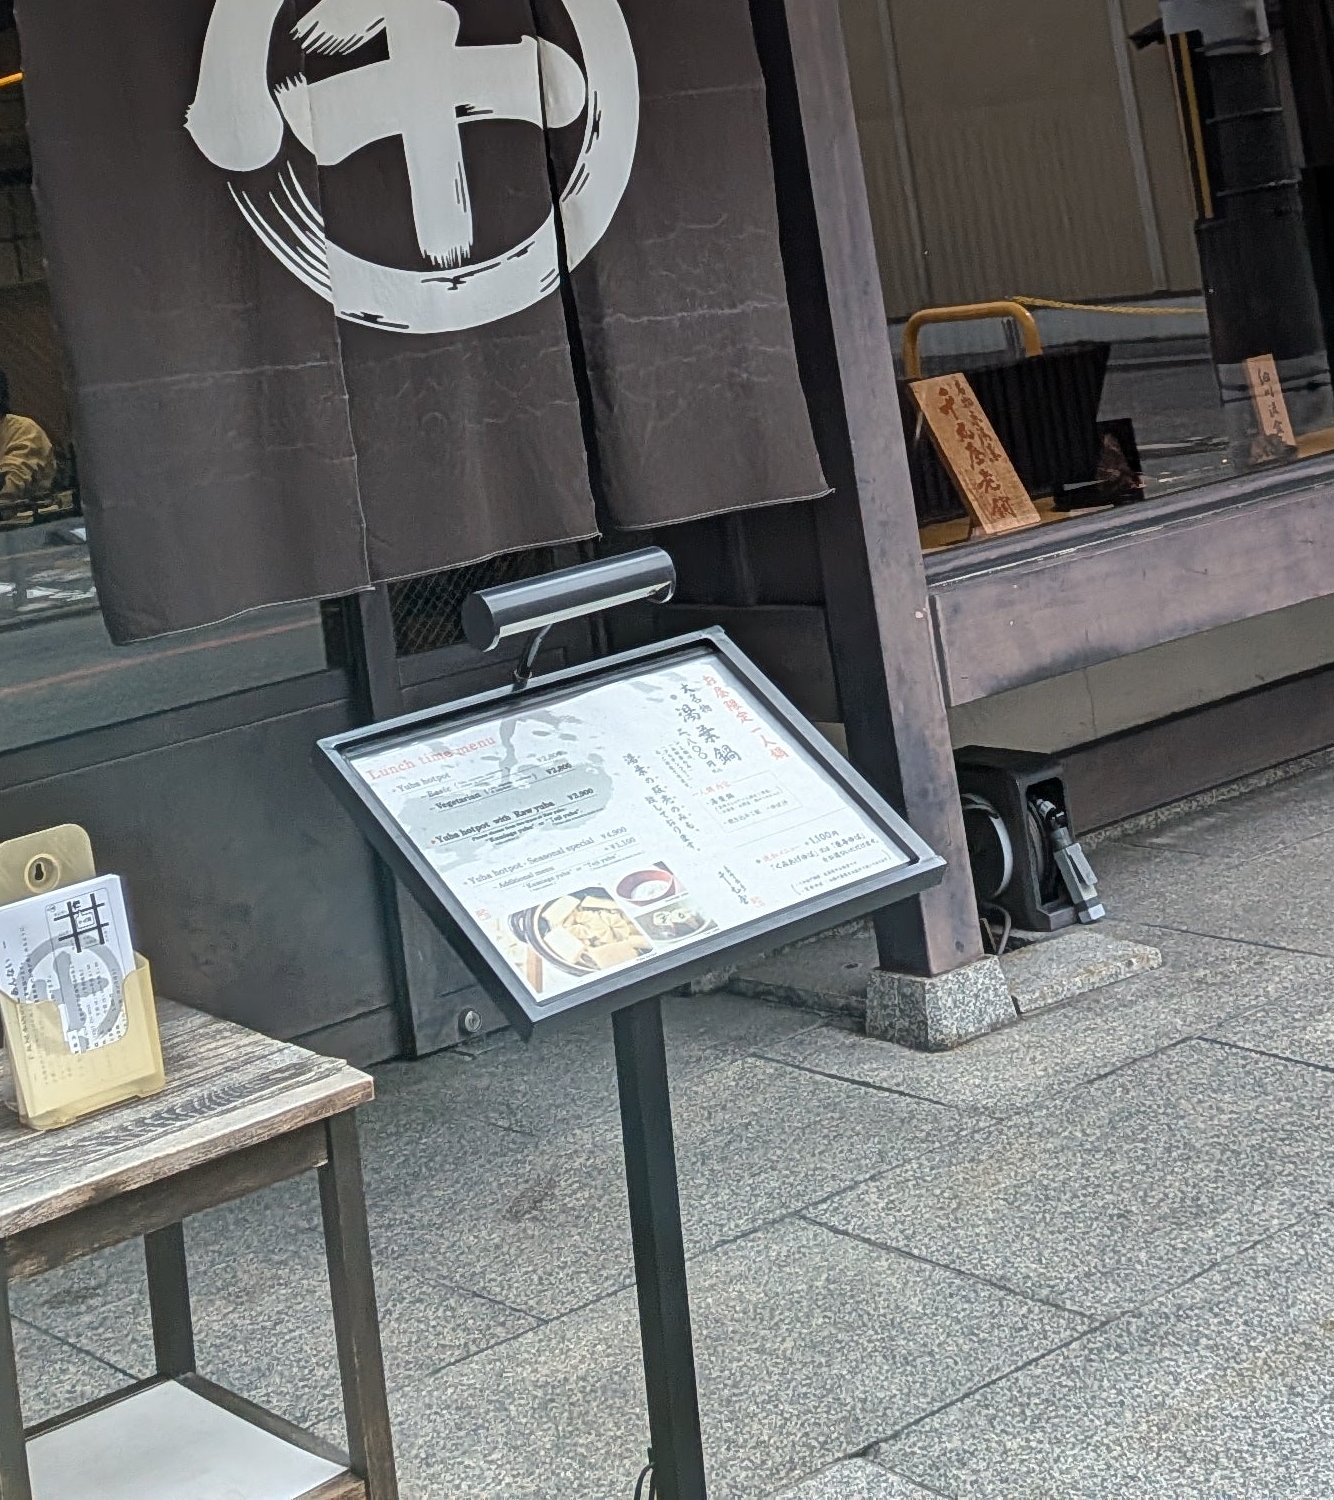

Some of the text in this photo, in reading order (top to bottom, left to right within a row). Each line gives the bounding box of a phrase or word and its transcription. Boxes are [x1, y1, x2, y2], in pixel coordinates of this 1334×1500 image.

[675, 704, 742, 765] 湯葉鍋
[367, 736, 497, 781] Lunch time menu
[396, 780, 420, 793] Yuba
[421, 772, 451, 787] hotpot
[435, 791, 482, 810] Vegetarian
[435, 831, 460, 844] Yuba
[460, 822, 491, 837] hotpot
[493, 814, 512, 825] with
[513, 807, 532, 818] Raw
[533, 800, 555, 815] yuba
[467, 873, 492, 885] Yuba
[494, 863, 523, 878] hotpot
[527, 847, 565, 864] Seasonal
[566, 837, 594, 852] special
[498, 873, 534, 888] Additional
